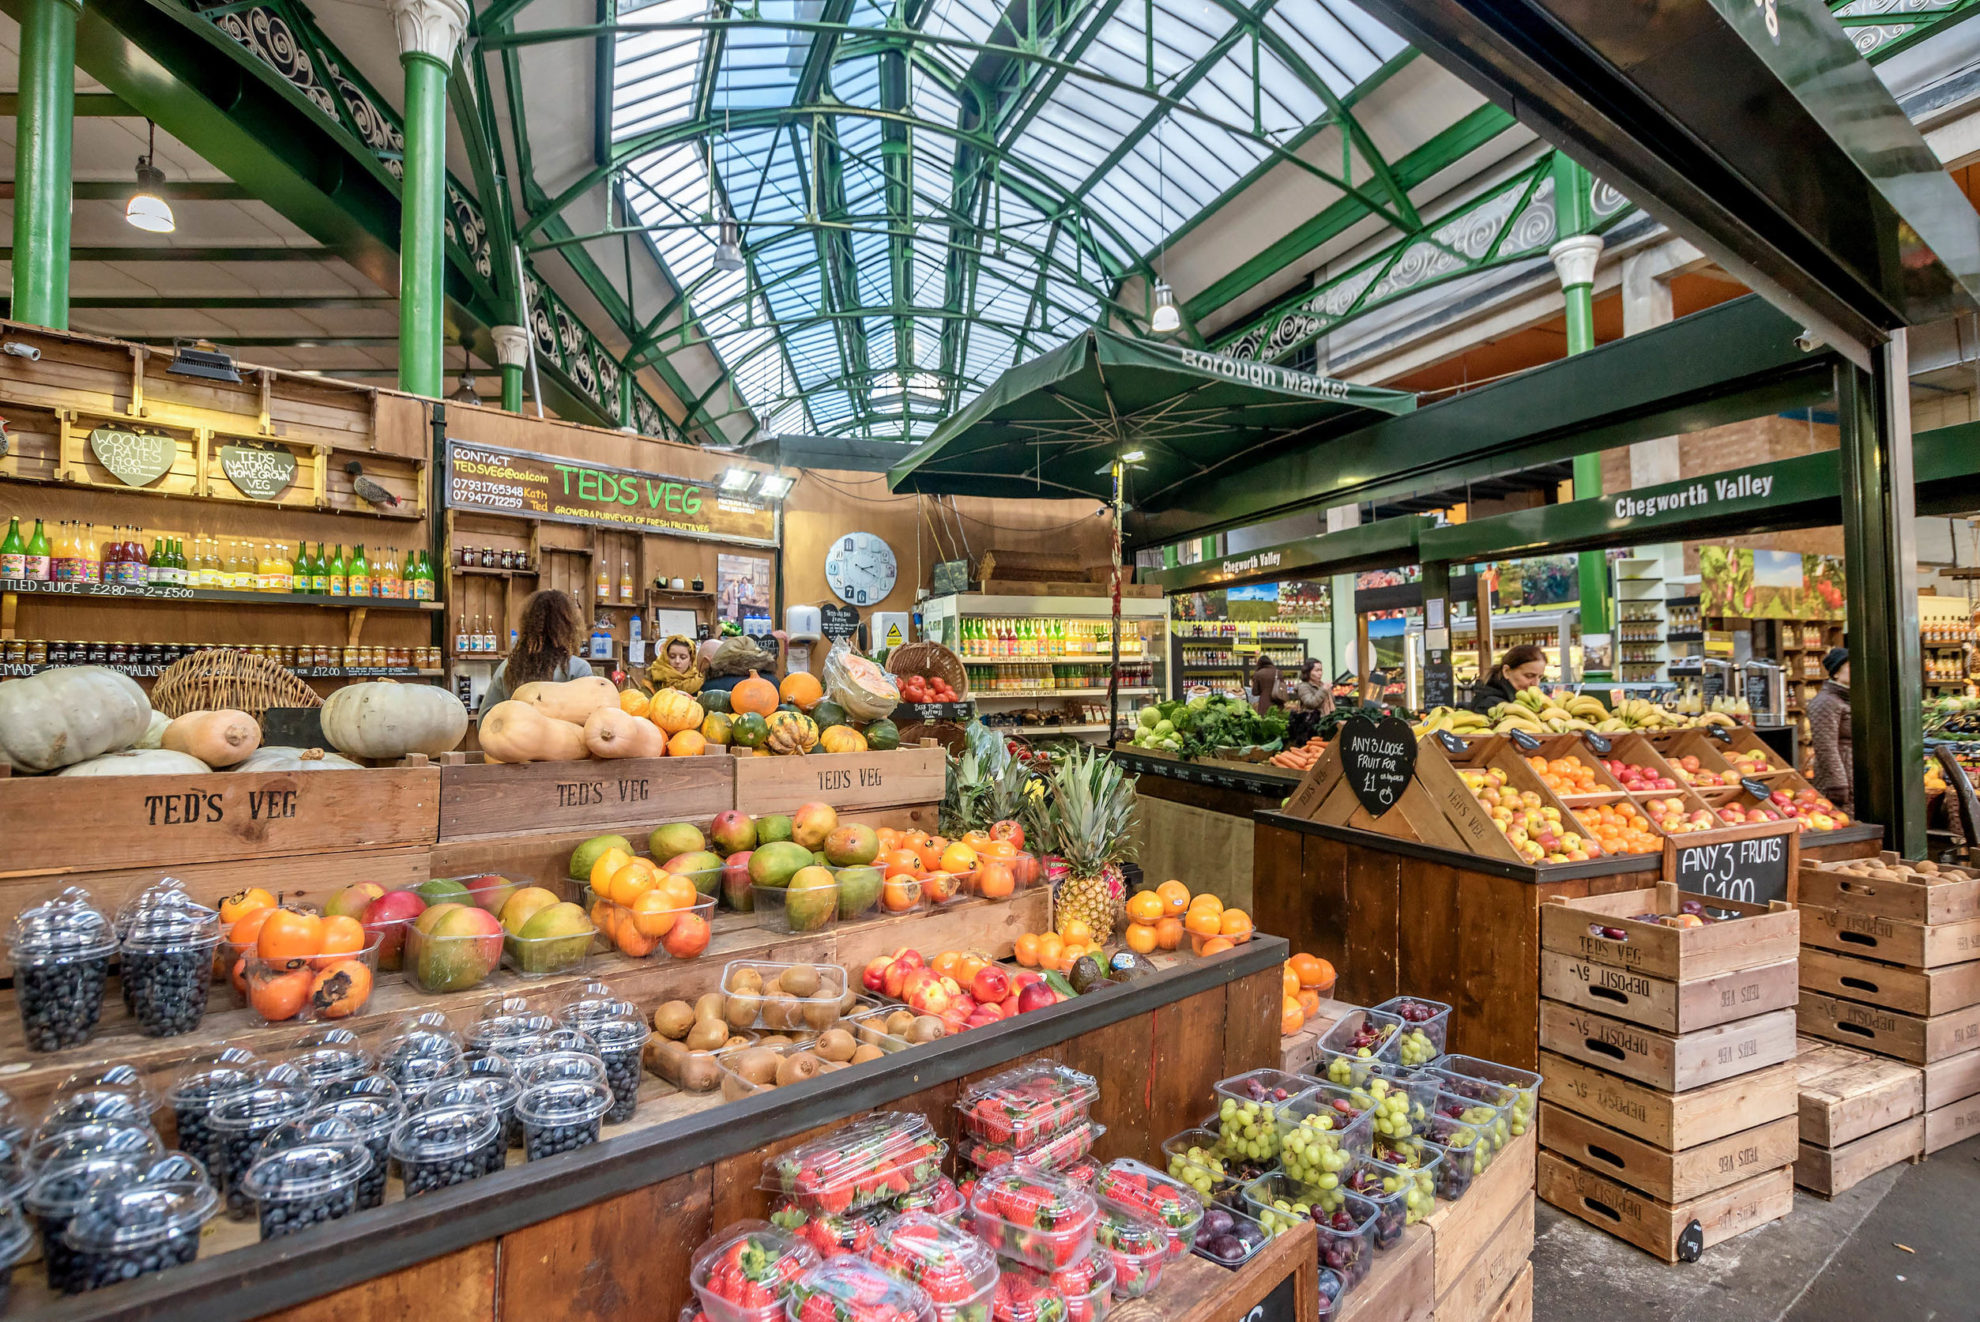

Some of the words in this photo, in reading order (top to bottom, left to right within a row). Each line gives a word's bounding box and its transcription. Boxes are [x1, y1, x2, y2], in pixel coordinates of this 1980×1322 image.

[1181, 349, 1276, 387] Borough
[1283, 371, 1350, 400] Market
[94, 430, 162, 450] WOODEN
[99, 444, 161, 463] CRATES
[453, 448, 510, 467] CONTACT
[225, 460, 294, 474] NATURALLY
[246, 480, 270, 490] VEG
[453, 477, 524, 497] 07931765348
[524, 487, 548, 500] Kath
[554, 464, 639, 506] TED'S
[646, 479, 702, 515] VEG
[1615, 484, 1708, 518] Chegworth
[1715, 474, 1773, 502] Valley
[453, 490, 523, 508] 07947712259
[531, 500, 548, 512] Ted
[636, 516, 645, 525] OF
[646, 518, 669, 528] FRESH
[1223, 555, 1258, 574] Chegworth
[1260, 552, 1280, 566] Valley
[42, 582, 81, 594] JUICE
[1352, 736, 1370, 752] ANY
[1371, 738, 1378, 752] 3
[1379, 739, 1404, 756] LOOSE
[1357, 754, 1381, 769] FRUIT
[1382, 758, 1395, 771] FOR
[817, 770, 851, 790] TED'S
[859, 767, 882, 787] VEG
[557, 782, 603, 807] TED'S
[619, 779, 649, 803] VEG
[145, 792, 223, 825] TED'S
[248, 790, 297, 820] VEG
[1682, 845, 1719, 874] ANY
[1720, 843, 1734, 880] 3
[1741, 838, 1782, 864] FRUITS
[1618, 945, 1641, 965] VEG
[1599, 968, 1650, 998] DEPOSIT
[1721, 990, 1737, 1008] VEG
[1846, 1007, 1895, 1032] DEPOSIT
[1599, 1019, 1648, 1056] DEPOSIT
[1718, 1046, 1734, 1064] VEG
[1597, 1088, 1647, 1123] DEPOSIT
[1719, 1155, 1735, 1173] VEG
[1592, 1180, 1642, 1221] DEPOSIT
